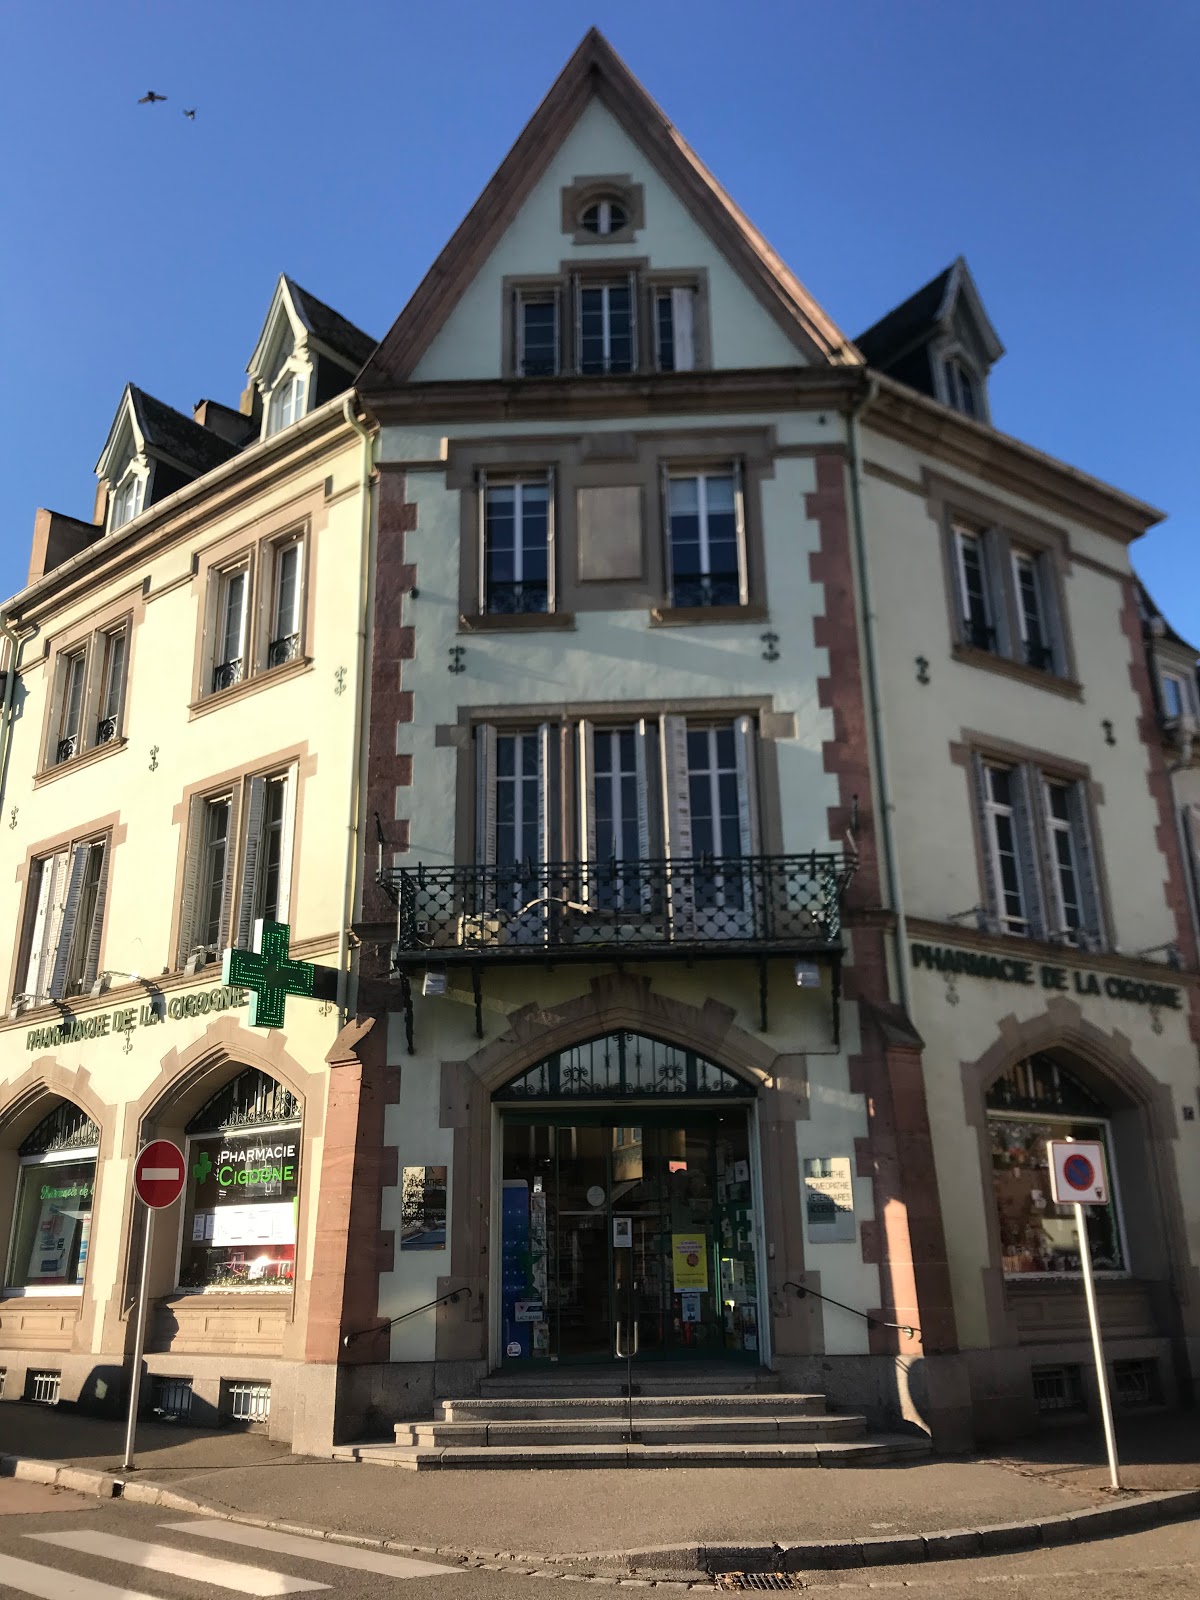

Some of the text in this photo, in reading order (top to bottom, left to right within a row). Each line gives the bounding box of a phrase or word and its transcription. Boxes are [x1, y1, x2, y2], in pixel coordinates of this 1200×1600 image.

[911, 942, 1182, 1010] PHARMACIE DE LA CIGOGNE
[26, 987, 247, 1051] PHARMACIE DE LA CIGOGNE
[219, 1165, 294, 1187] CIGOGNE
[220, 1145, 295, 1164] PHARMACIE
